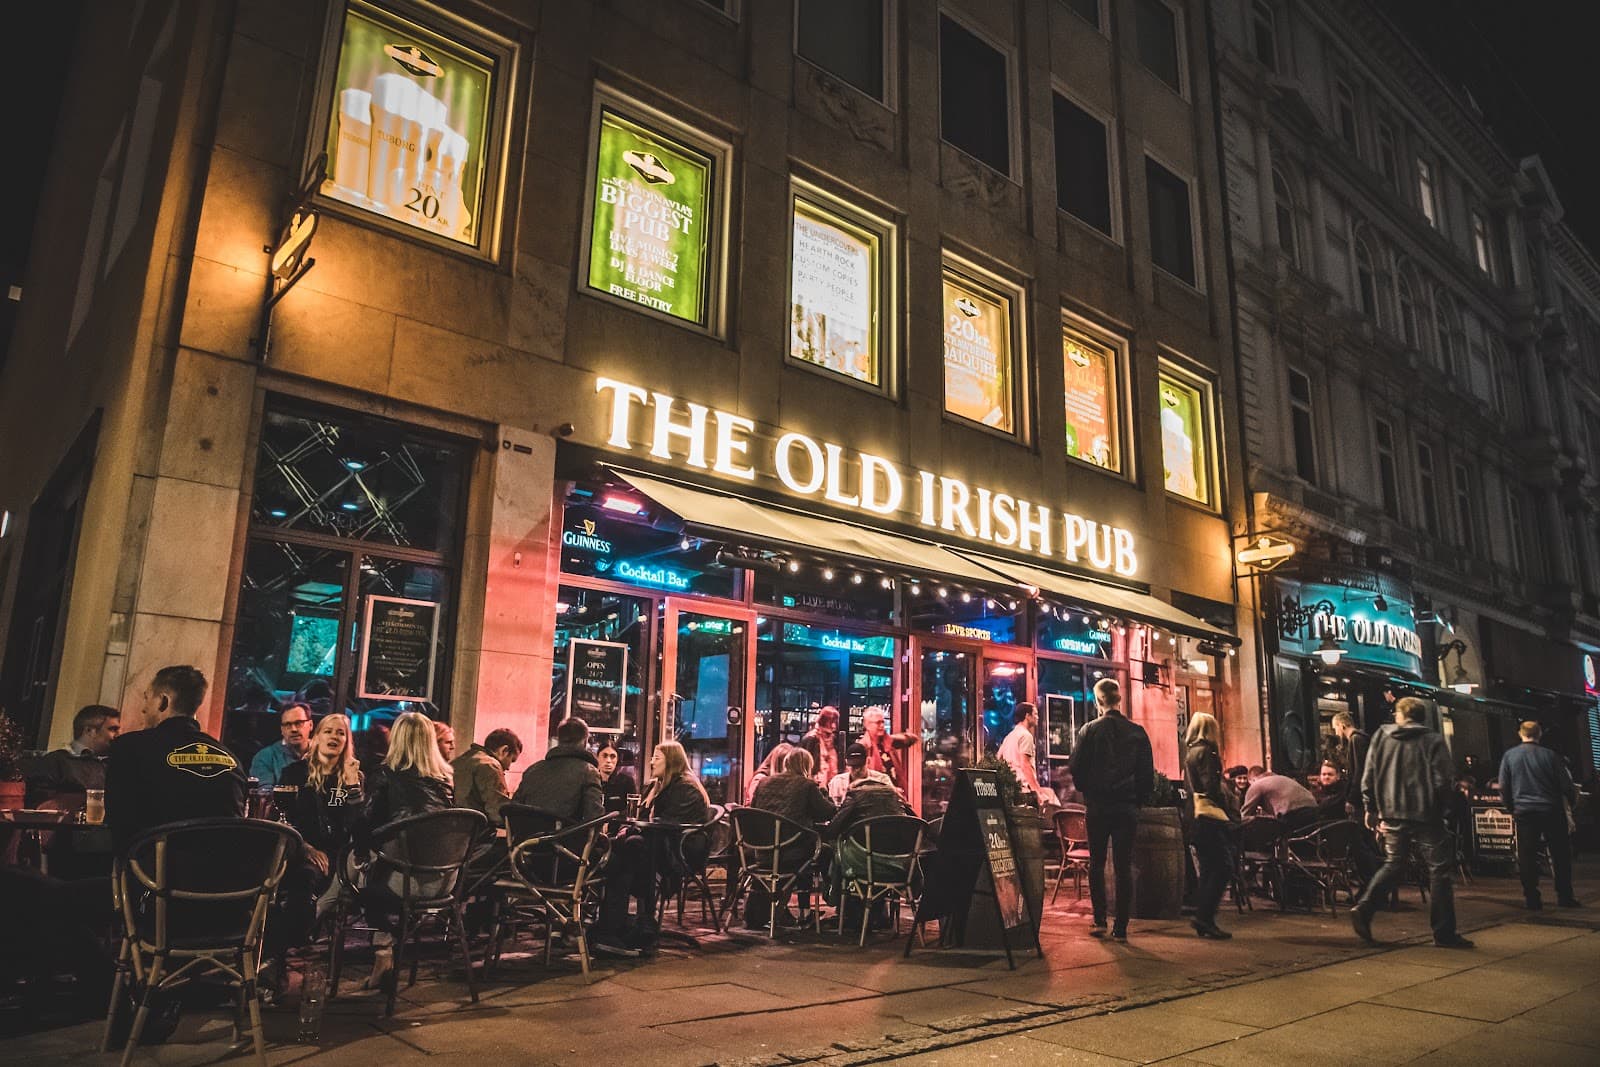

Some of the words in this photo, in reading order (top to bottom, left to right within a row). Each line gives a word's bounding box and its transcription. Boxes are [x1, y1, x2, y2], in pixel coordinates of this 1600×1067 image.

[404, 187, 440, 219] 20
[600, 183, 693, 235] BIGGEST
[624, 210, 669, 241] PUB
[610, 256, 625, 273] DJ
[639, 266, 675, 289] DANCE
[651, 254, 678, 273] WEEK
[834, 254, 855, 270] ROCK
[625, 271, 662, 292] FLOOR
[609, 283, 637, 301] FREE
[638, 293, 672, 312] ENTRY
[596, 377, 755, 480] THE
[775, 432, 903, 514] OLD
[919, 470, 1052, 556] IRISH
[1064, 512, 1138, 577] PUB
[563, 531, 612, 553] GUINNESS
[619, 562, 665, 584] Cocktail
[668, 571, 688, 588] Bar
[945, 623, 965, 637] LIVE
[965, 627, 991, 640] SPORTS
[1313, 611, 1348, 641] THE
[1352, 620, 1385, 645] OLD
[822, 634, 851, 650] Cocktail
[852, 639, 866, 651] Bar
[587, 661, 605, 669] OPEN
[328, 787, 348, 806] R
[974, 781, 998, 797] TUBORG
